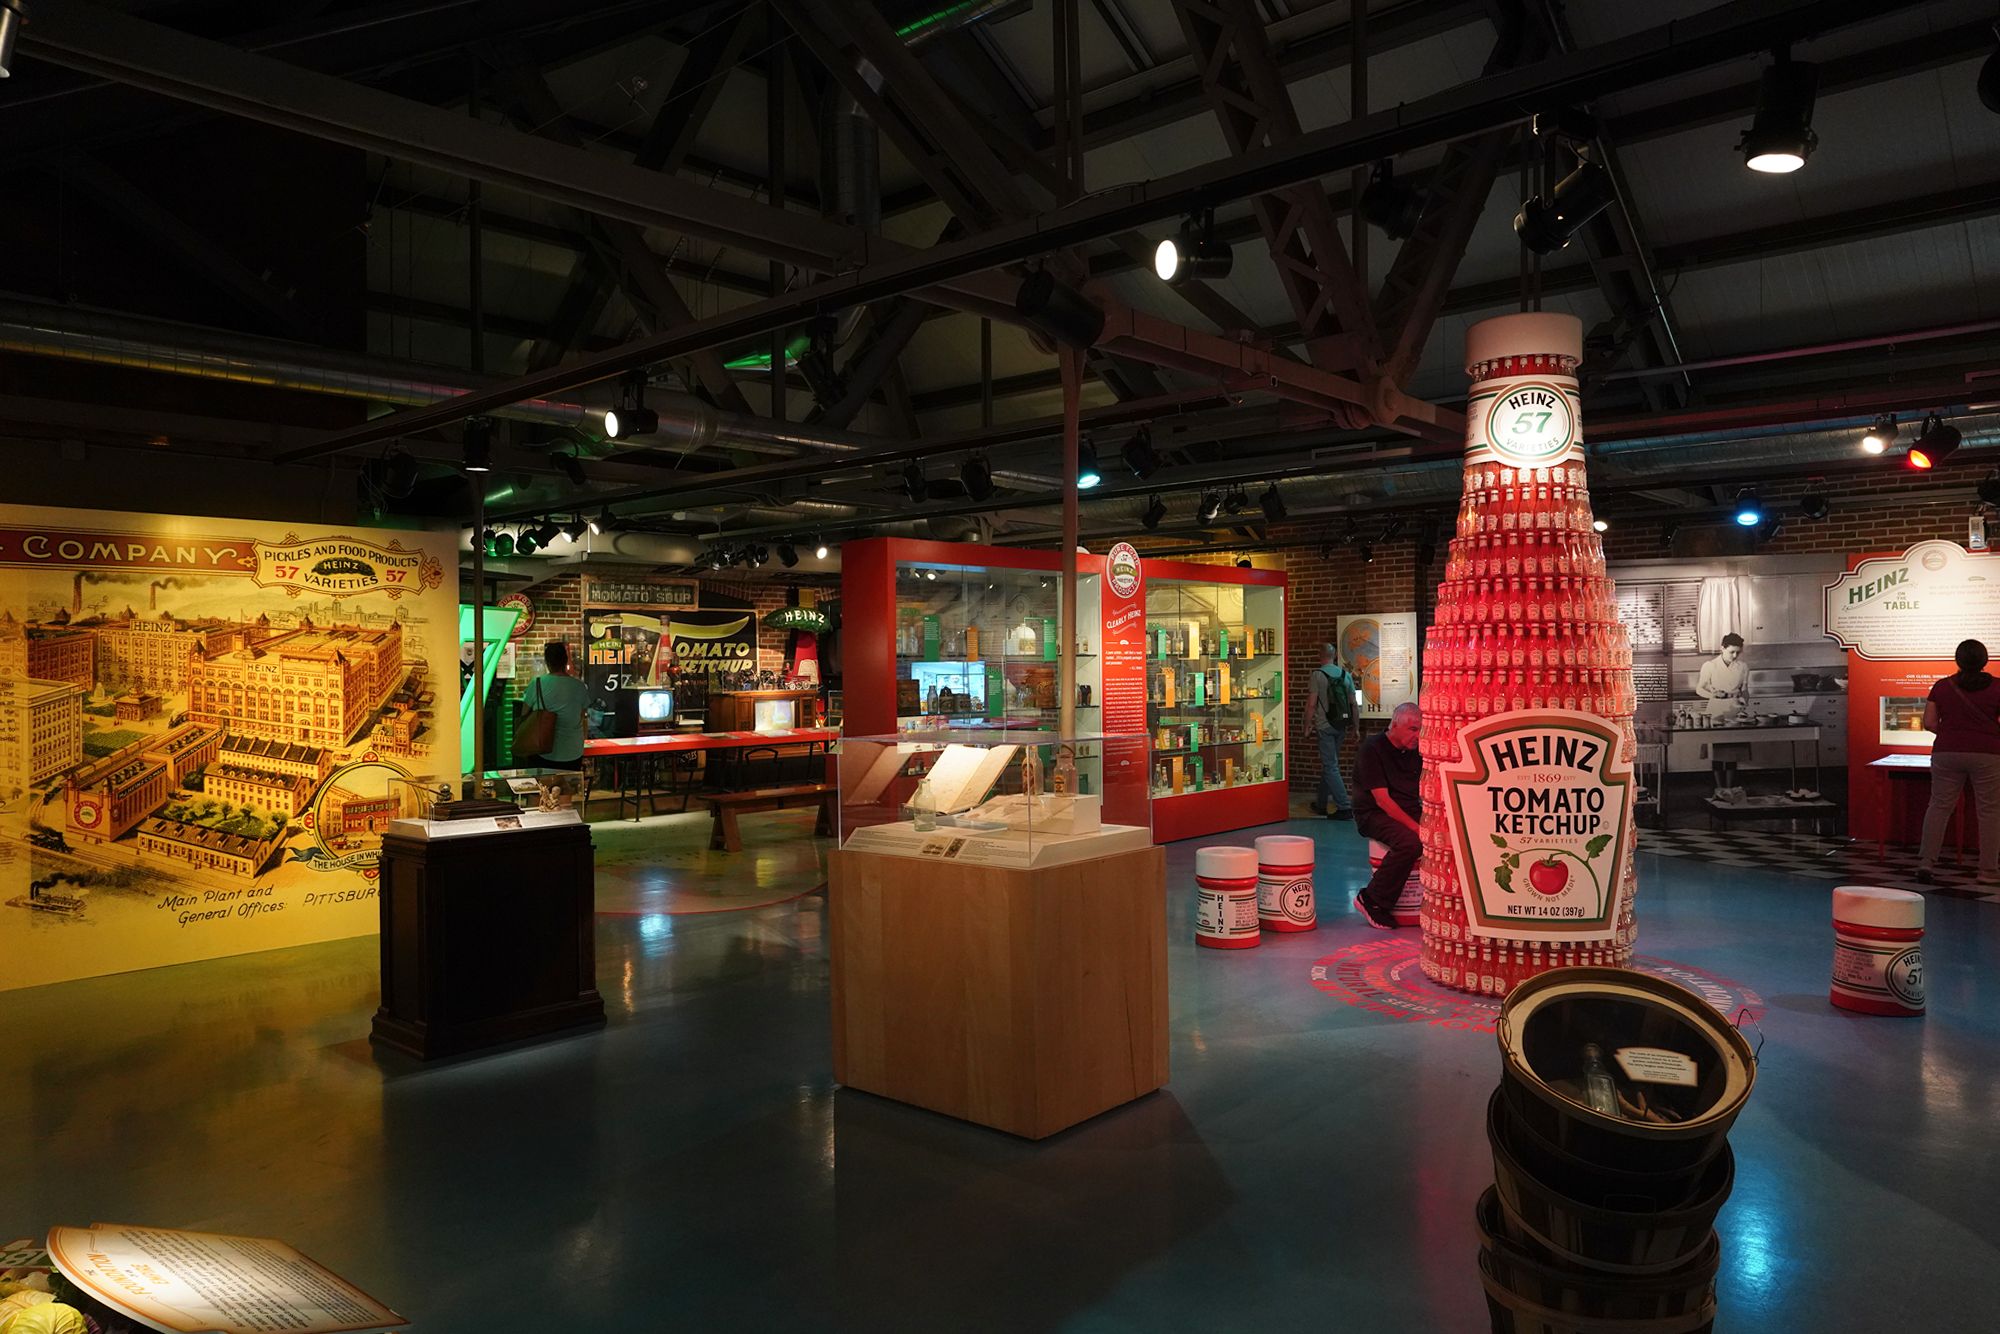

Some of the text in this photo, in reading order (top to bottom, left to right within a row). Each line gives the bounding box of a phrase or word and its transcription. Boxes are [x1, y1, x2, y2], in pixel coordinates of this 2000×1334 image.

[1508, 392, 1556, 410] HEINZ
[1511, 411, 1553, 435] 57
[1506, 437, 1560, 452] VARIETIES
[22, 535, 238, 565] COMPANY
[264, 544, 419, 568] PICKLES AND FOOD PRODUCTS
[1111, 544, 1125, 561] PURE
[274, 565, 300, 580] 57
[323, 560, 360, 571] HEINZ
[303, 572, 379, 590] VARIETIES
[385, 569, 408, 583] 57
[1849, 567, 1910, 605] HEINZ
[1883, 600, 1920, 611] TABLE
[784, 610, 826, 624] HEINZ
[1106, 609, 1142, 629] CLEARLY HEINZ
[133, 622, 171, 633] HEINZ
[247, 664, 278, 674] HEINZ
[679, 659, 753, 674] KETCHUP
[604, 674, 632, 692] 57
[1490, 735, 1599, 773] HEINZ
[1533, 773, 1562, 783] 1869
[1487, 786, 1605, 814] TOMATO
[1495, 813, 1601, 836] KETCHUP
[1519, 836, 1533, 844] 57
[313, 849, 382, 869] THE HOUSE IN WHI
[157, 884, 274, 912] Main Plant and
[1292, 885, 1311, 895] HEINZ
[1522, 877, 1543, 901] GROWN
[1545, 895, 1560, 903] NOT
[1294, 894, 1311, 908] 57
[178, 905, 232, 928] General
[1216, 894, 1224, 934] HEINZ
[1507, 905, 1585, 918] NET WT 14 OZ (397g)
[1335, 962, 1385, 998] NATURAL
[1311, 979, 1497, 1035] ANTICIPATION
[1381, 997, 1440, 1015] SEEDS
[1471, 1002, 1501, 1010] SLO
[86, 1253, 153, 1295] FOUNDATION
